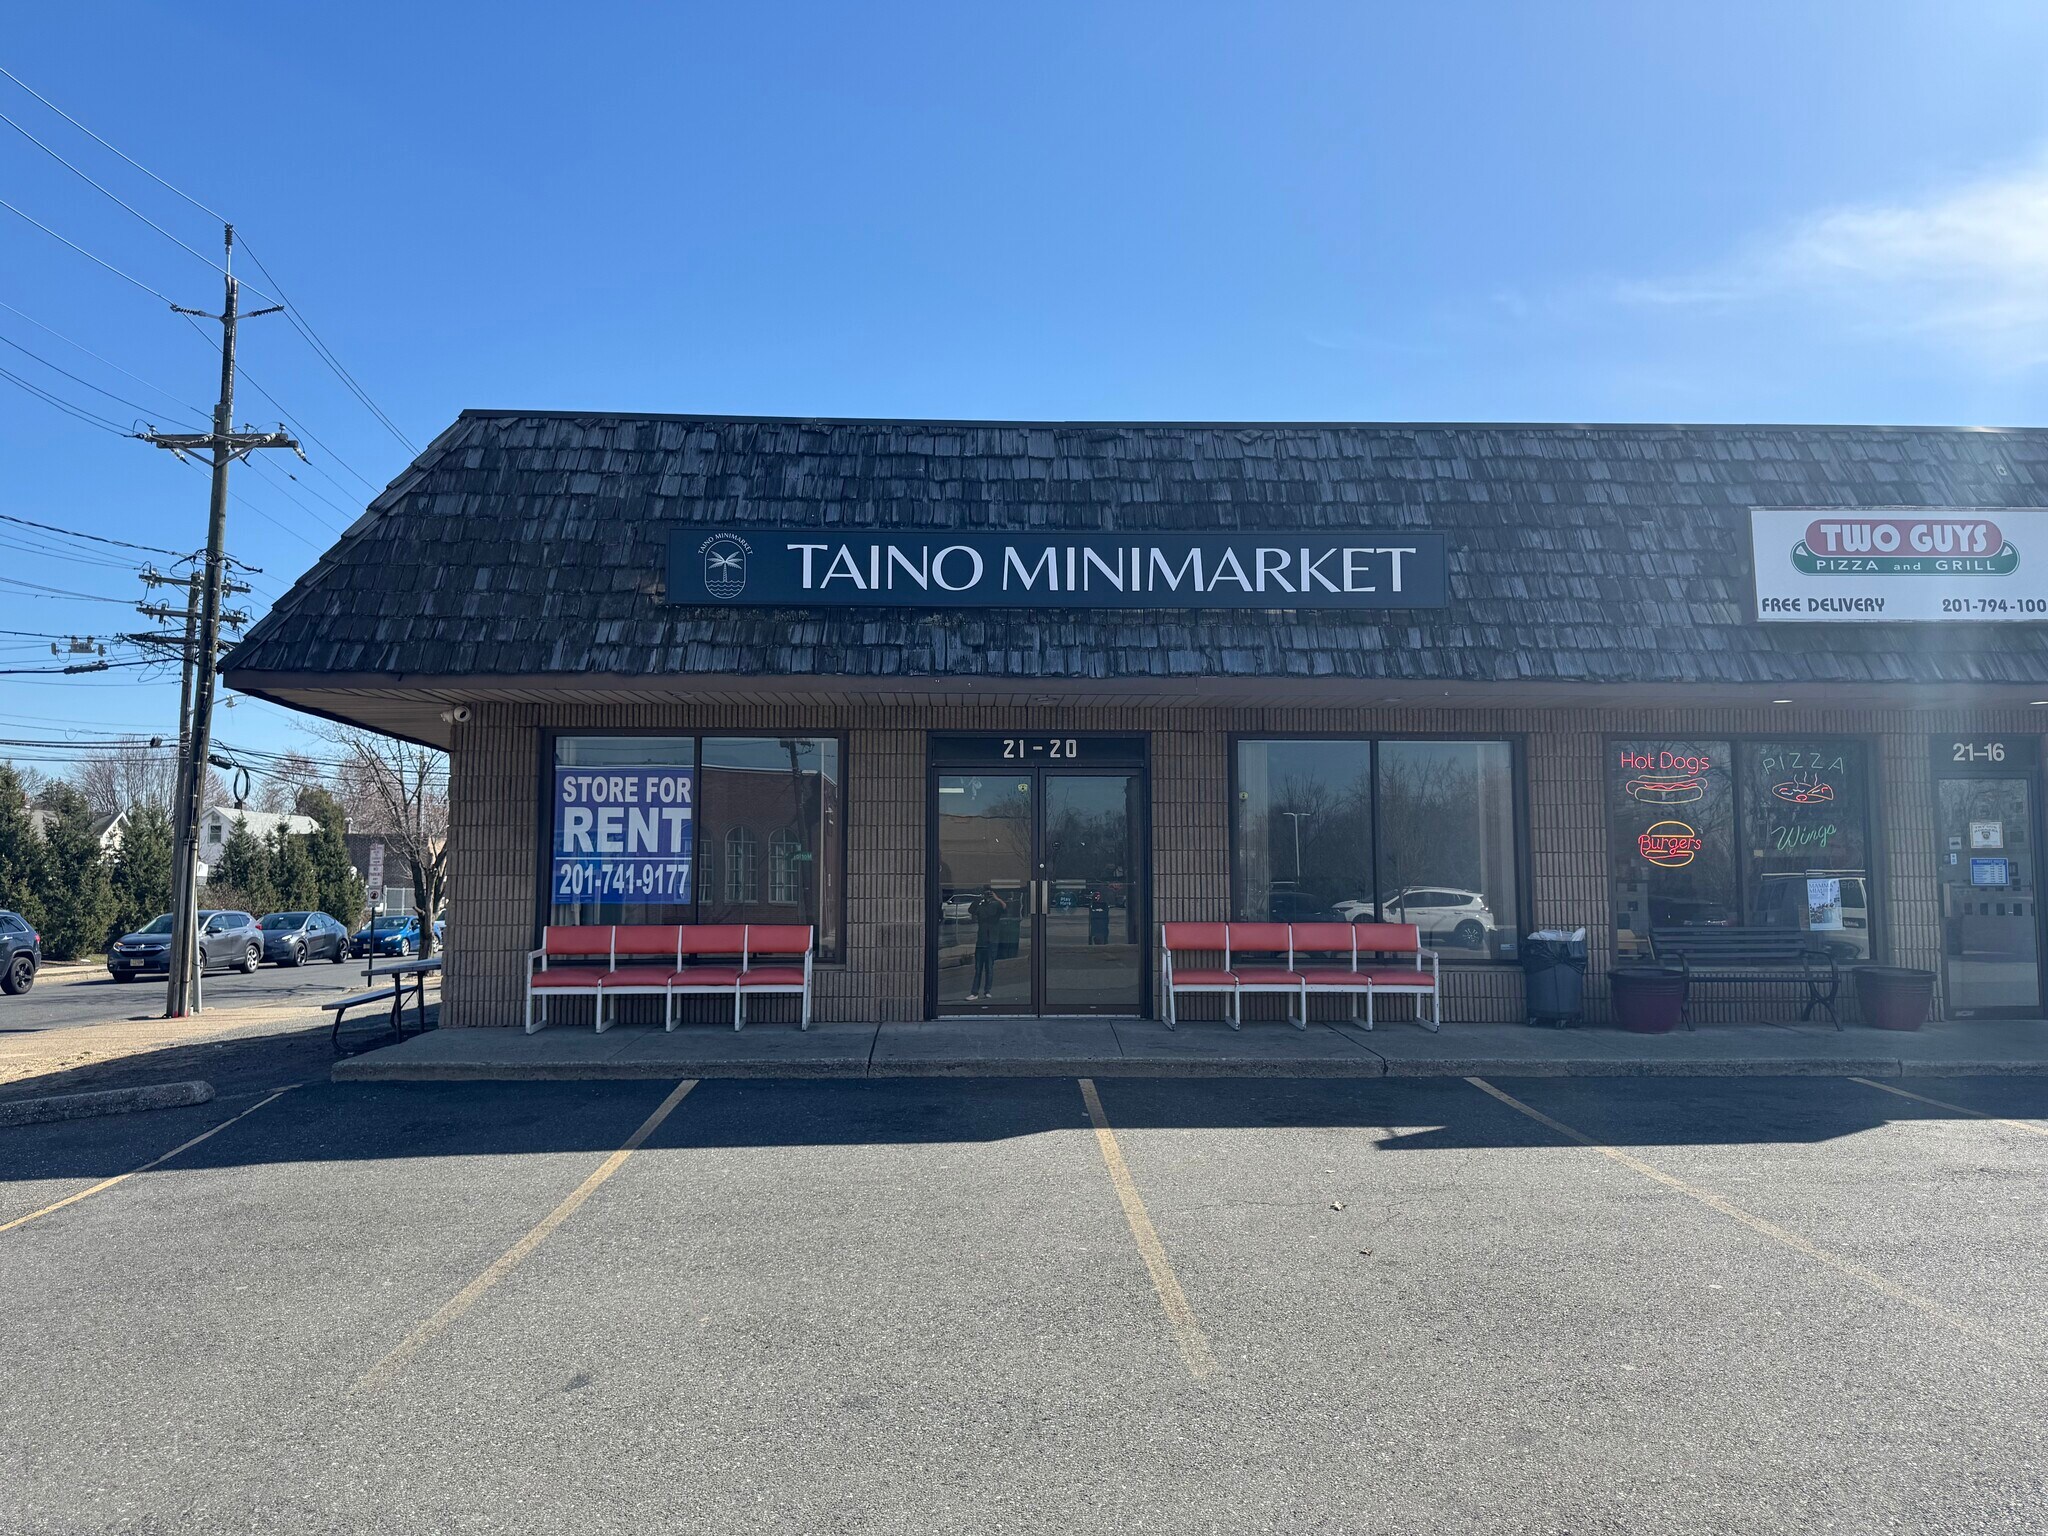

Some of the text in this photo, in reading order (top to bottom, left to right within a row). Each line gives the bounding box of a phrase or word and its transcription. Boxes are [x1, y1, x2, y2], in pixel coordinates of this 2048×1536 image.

[697, 532, 754, 556] TAINO MINIMARKET
[1820, 524, 1987, 553] TWO GUYS
[787, 543, 1416, 593] TAINO MINIMARKET
[1816, 559, 1996, 572] PIZZA and GRILL
[1761, 597, 1885, 613] FREE DELIVERY
[1942, 599, 2048, 614] 201-794-100
[1620, 751, 1710, 775] Hot Dogs
[1762, 752, 1845, 775] PIZZA
[1952, 742, 2005, 762] 21-16
[562, 775, 692, 803] STORE FOR
[562, 806, 692, 853] RENT
[1771, 823, 1837, 851] Wings
[1637, 833, 1702, 857] Burgers
[559, 863, 689, 895] 201-741-9177
